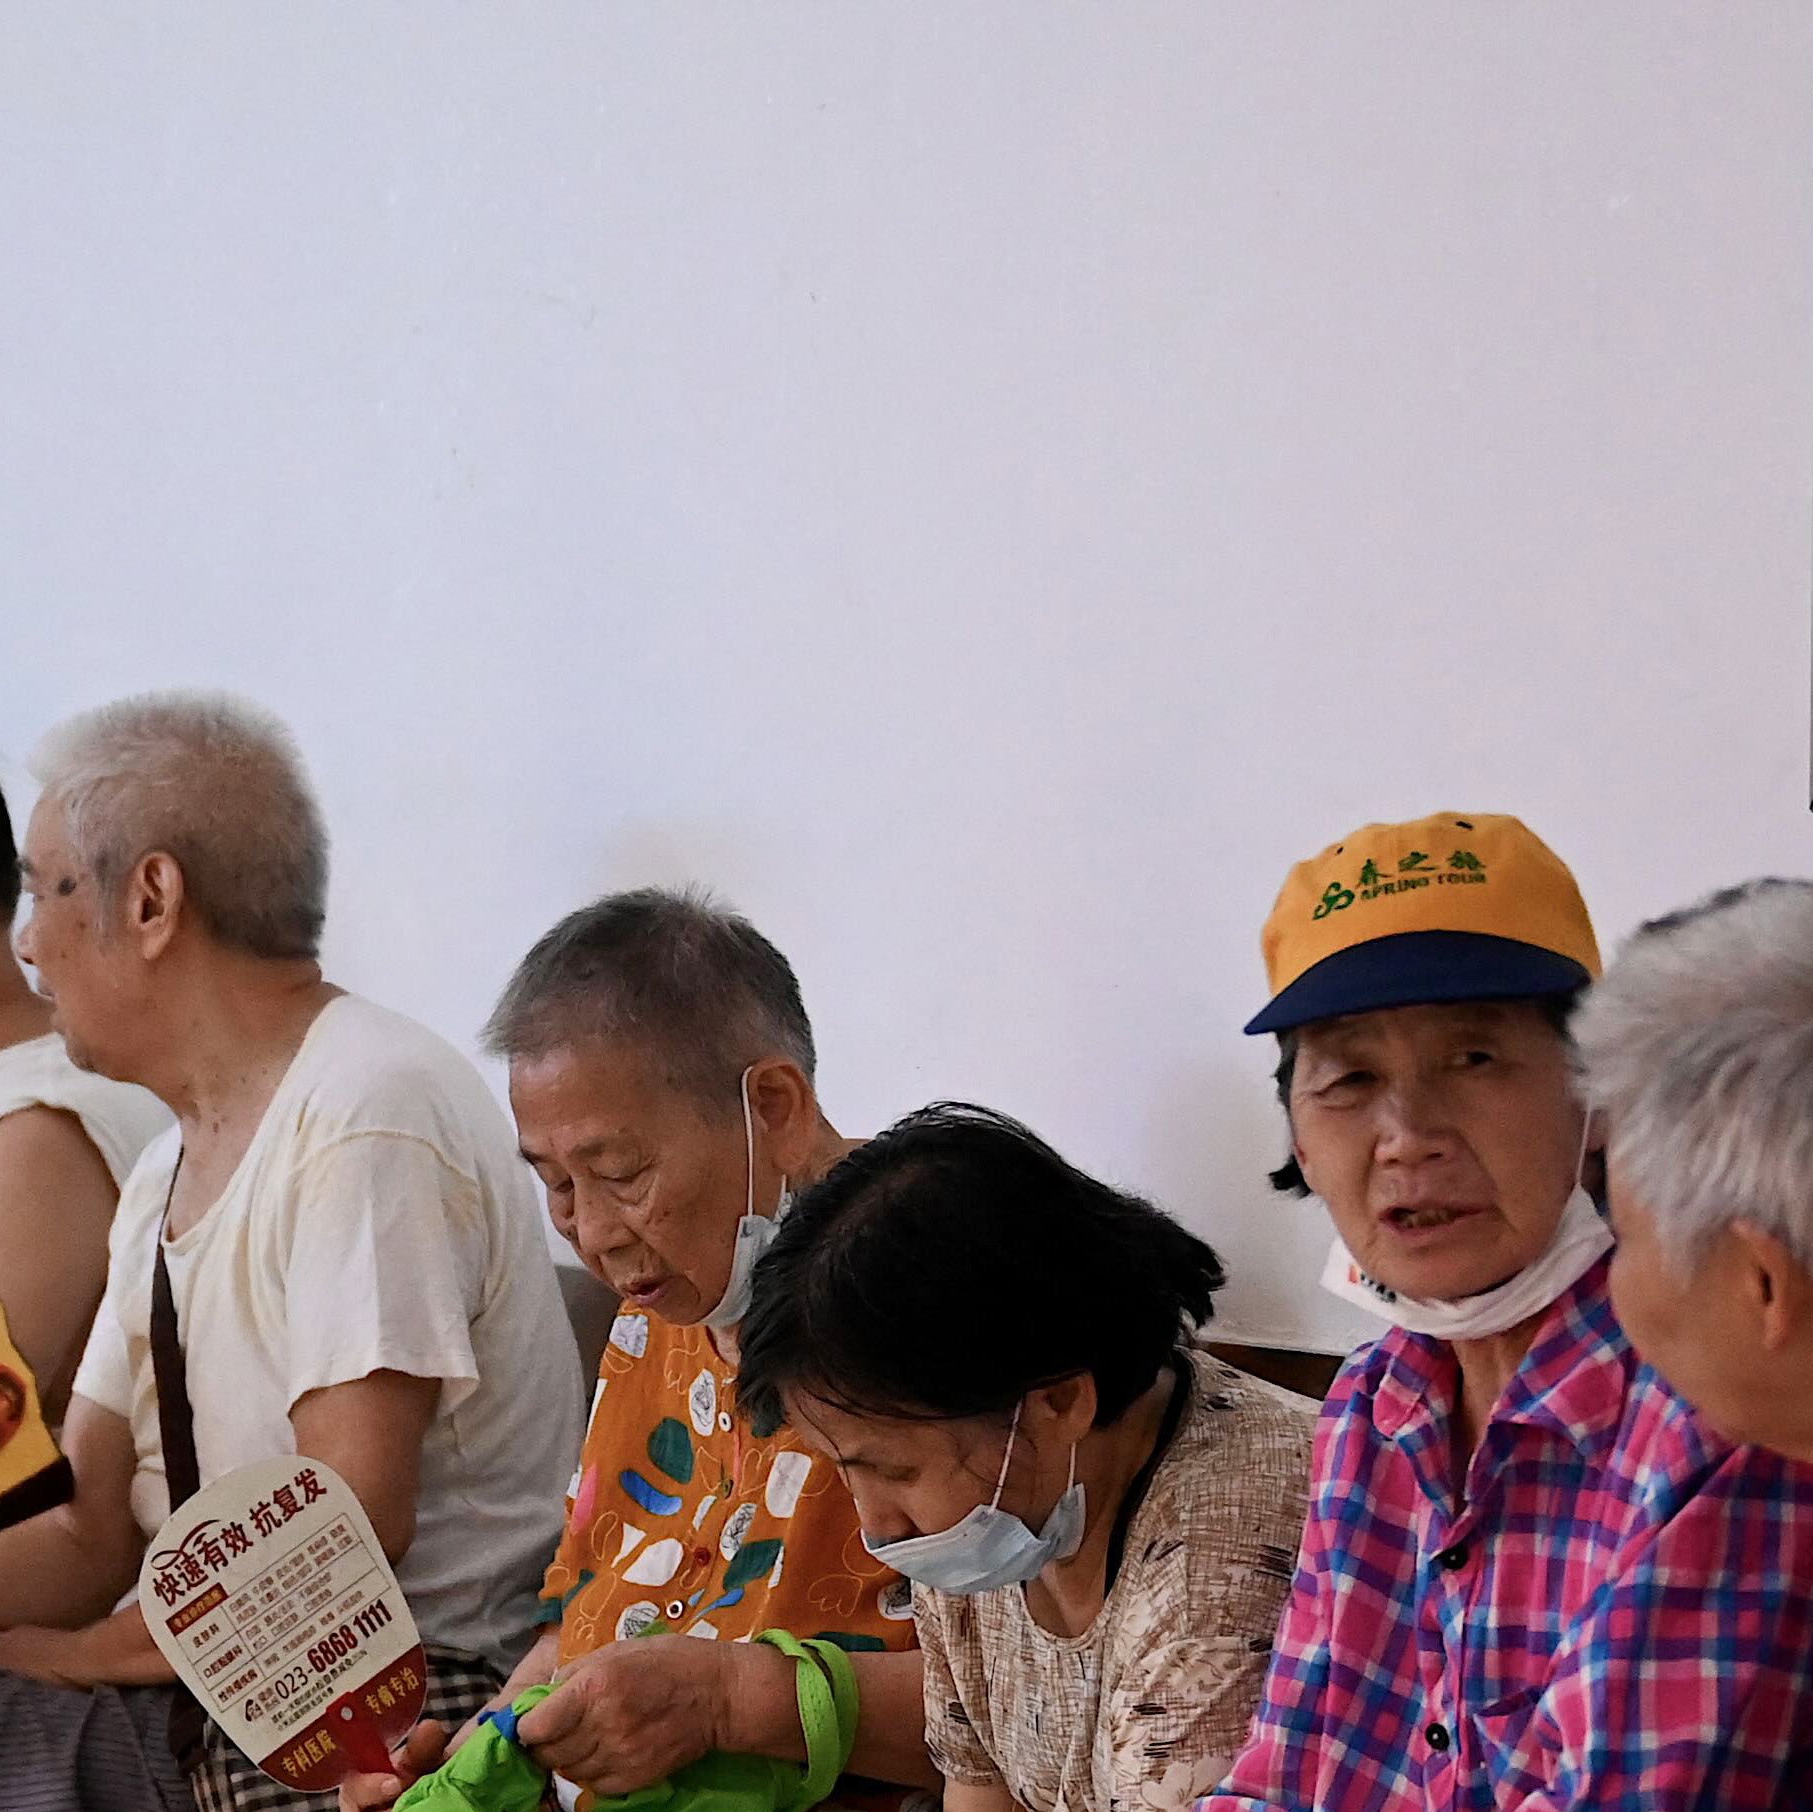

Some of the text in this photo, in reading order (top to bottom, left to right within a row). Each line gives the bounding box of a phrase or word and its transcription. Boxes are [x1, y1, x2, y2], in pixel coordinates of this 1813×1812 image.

[152, 1521, 254, 1607] 快速有效
[249, 1468, 327, 1538] 抗复发
[353, 1598, 394, 1640] 1111
[364, 1666, 420, 1715] 专病专治
[281, 1728, 337, 1779] 专科医院
